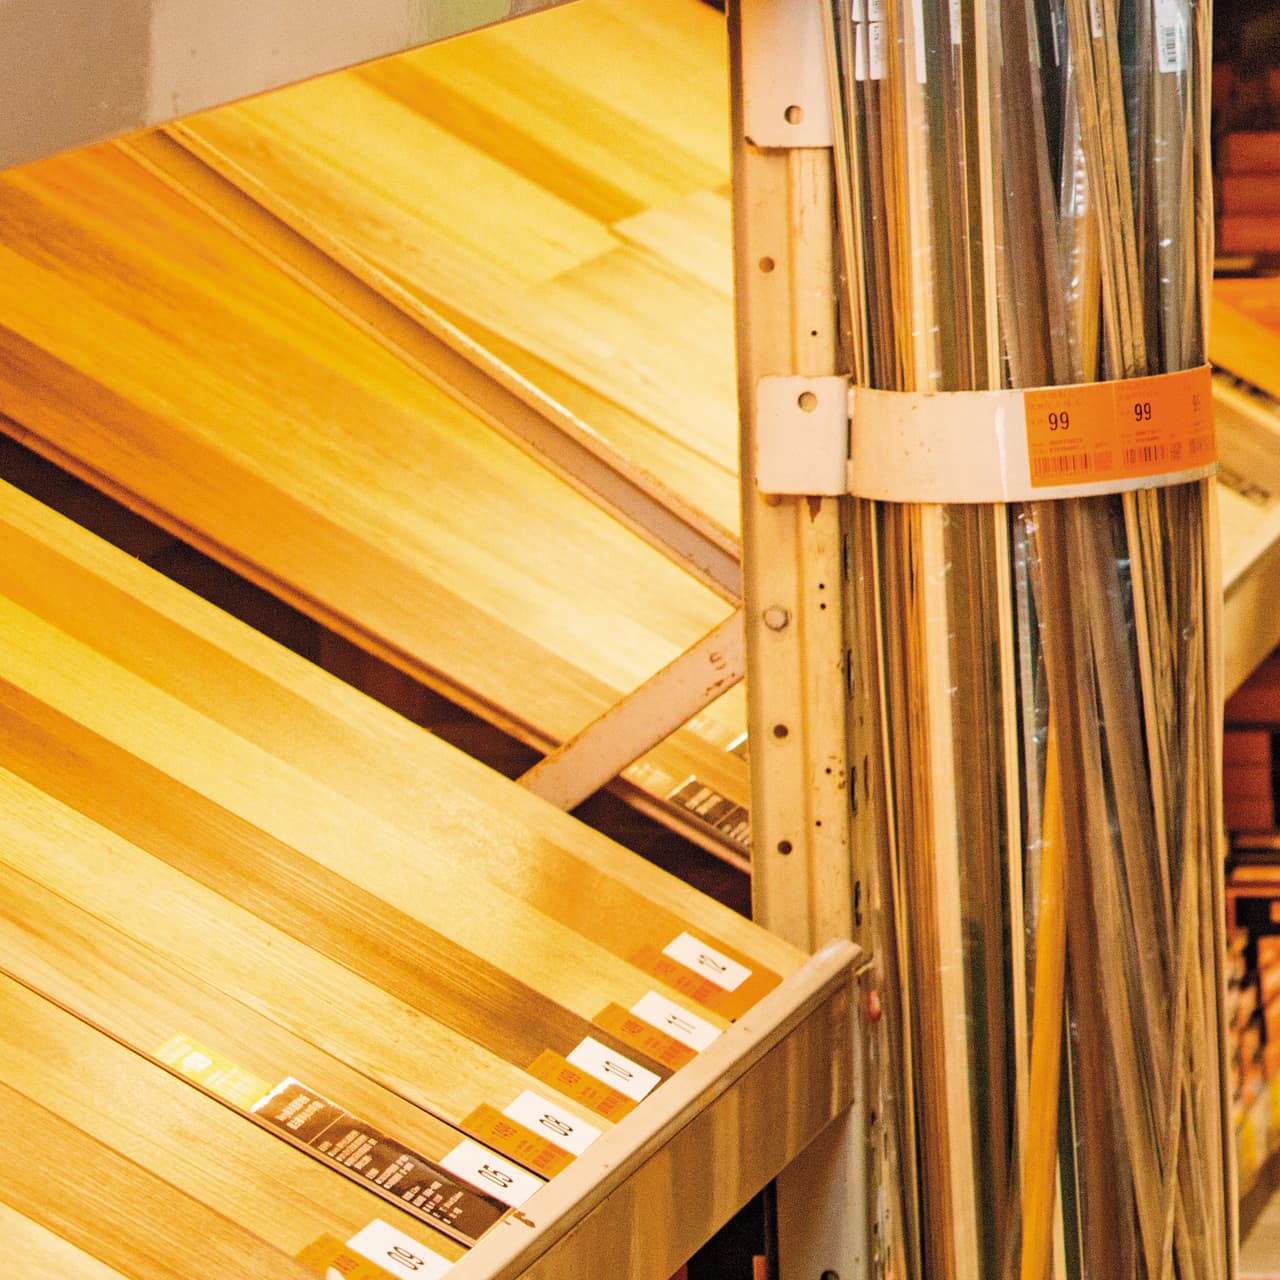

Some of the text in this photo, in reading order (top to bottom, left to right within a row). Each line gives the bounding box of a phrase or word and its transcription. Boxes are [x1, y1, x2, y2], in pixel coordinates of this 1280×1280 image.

[1048, 411, 1071, 432] 99
[1134, 401, 1152, 422] 99
[697, 953, 727, 975] 12
[665, 1014, 697, 1035] 11
[603, 1060, 634, 1082] 10
[539, 1114, 574, 1137] 08
[478, 1164, 514, 1189] 05
[387, 1245, 425, 1271] 09
